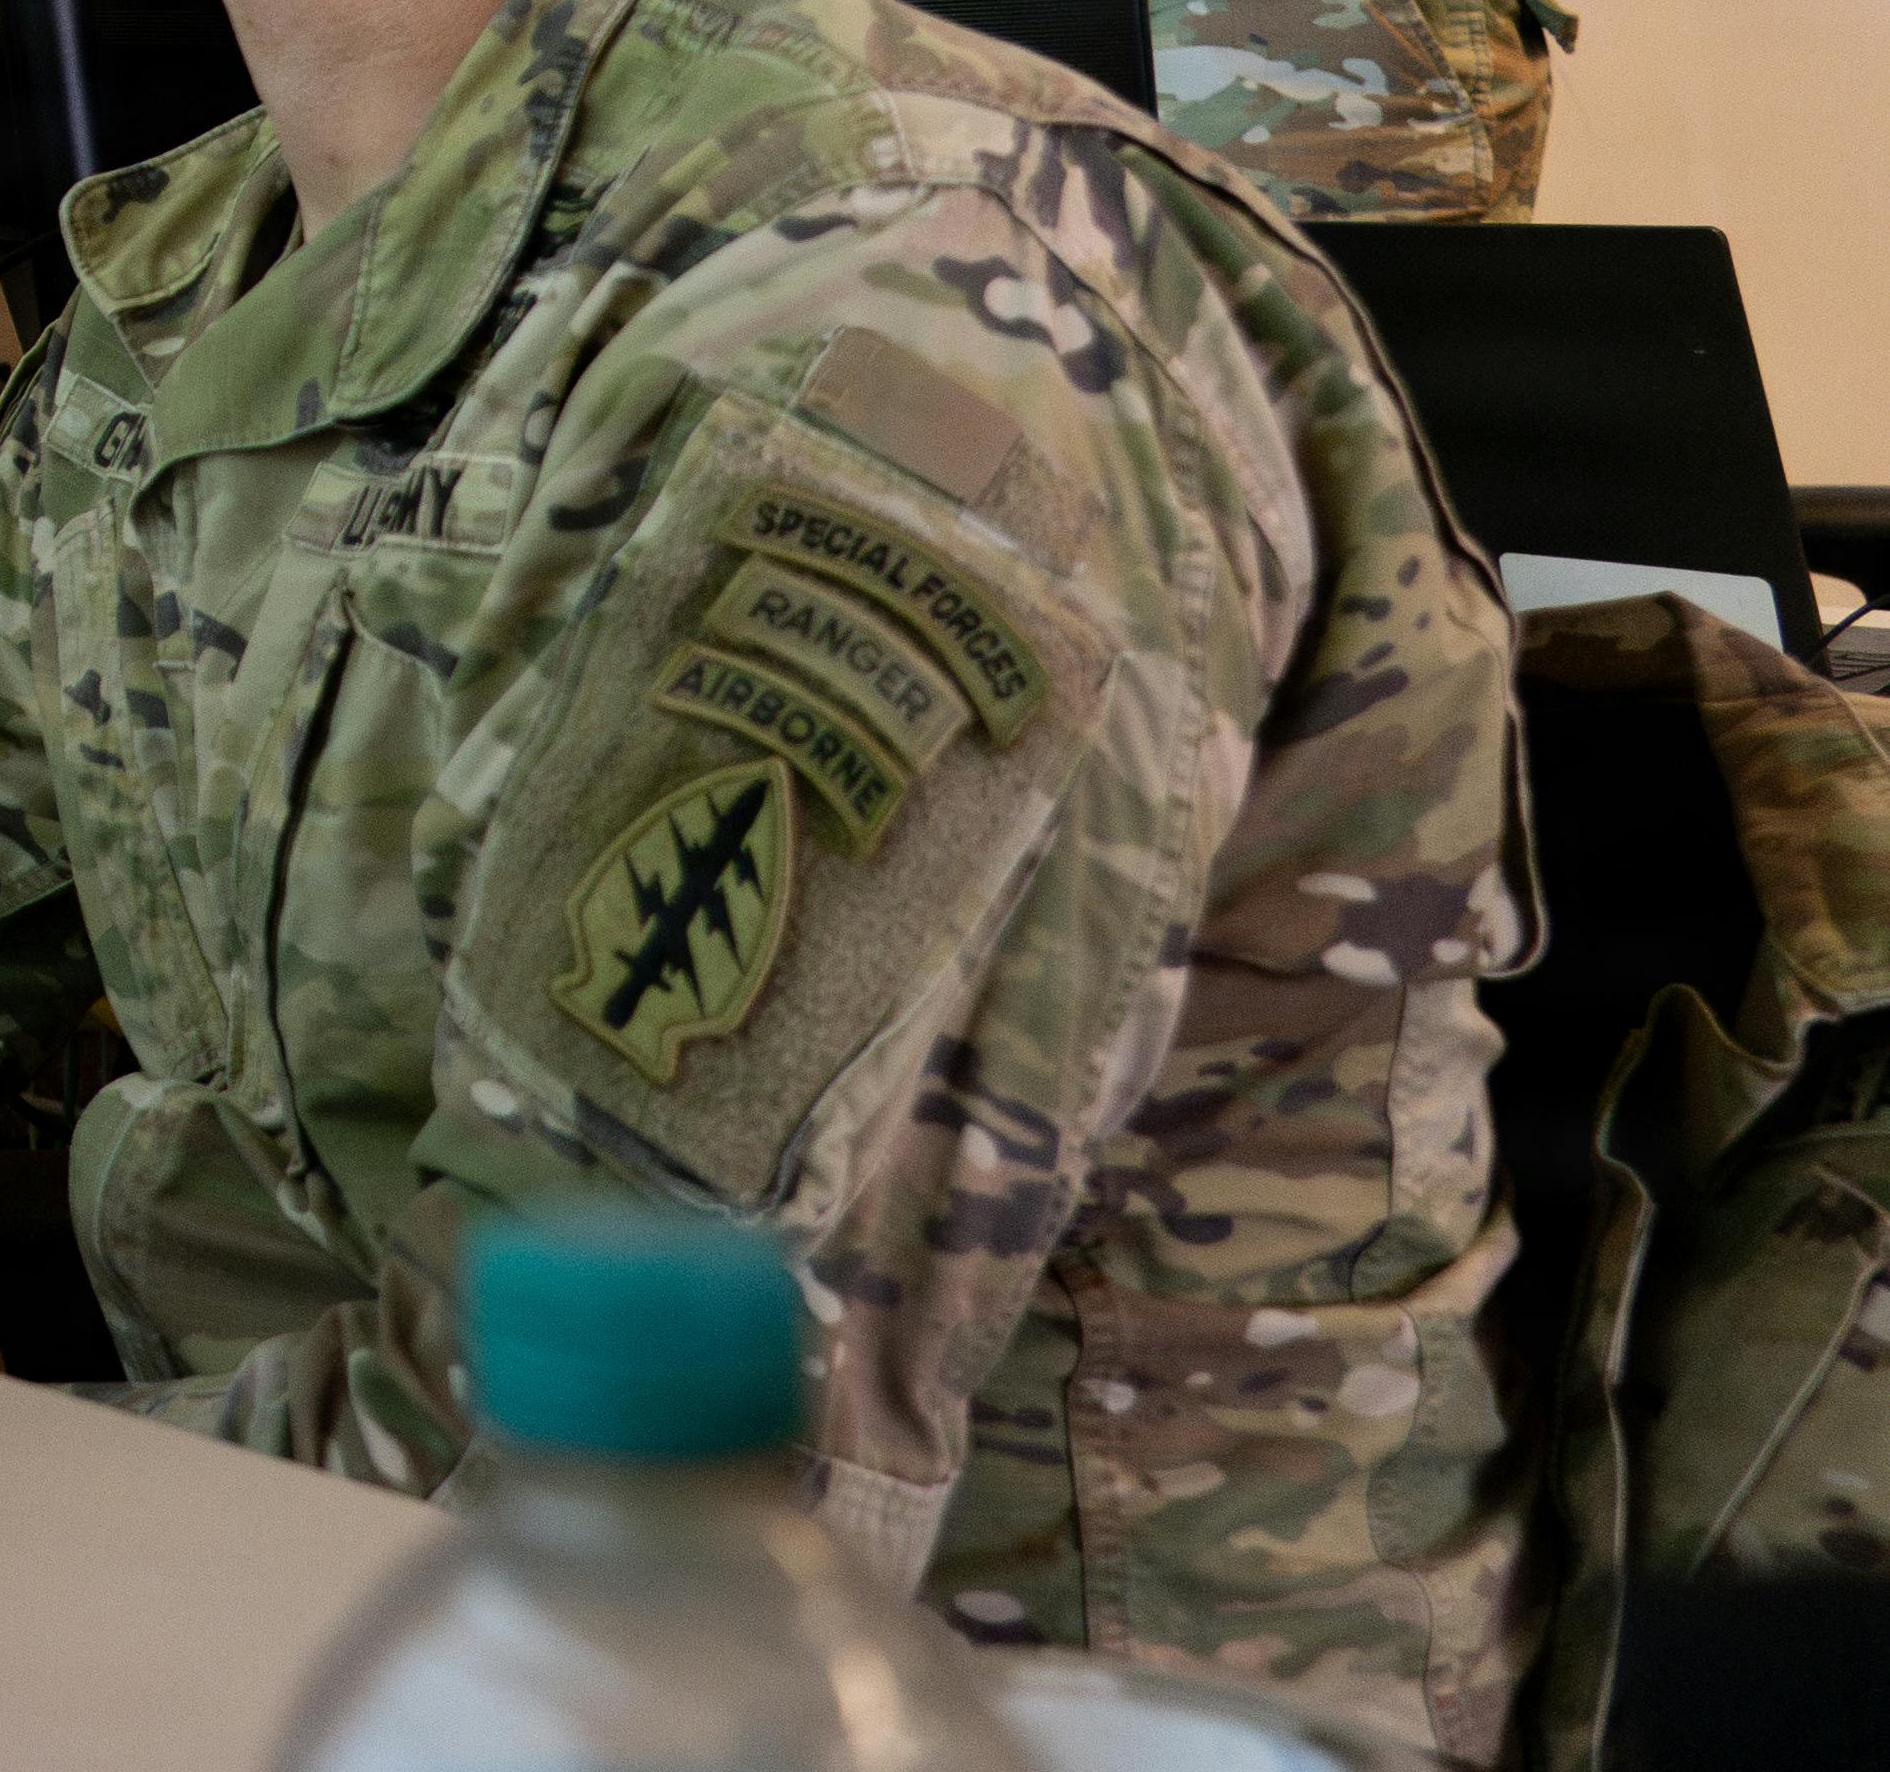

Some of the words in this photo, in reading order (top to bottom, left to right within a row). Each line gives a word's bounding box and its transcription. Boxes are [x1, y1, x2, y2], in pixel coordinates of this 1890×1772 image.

[749, 588, 934, 724] RANGER
[754, 500, 908, 591] SPECIAL
[910, 572, 1028, 701] FORCES
[667, 659, 888, 818] AIRBORNE
